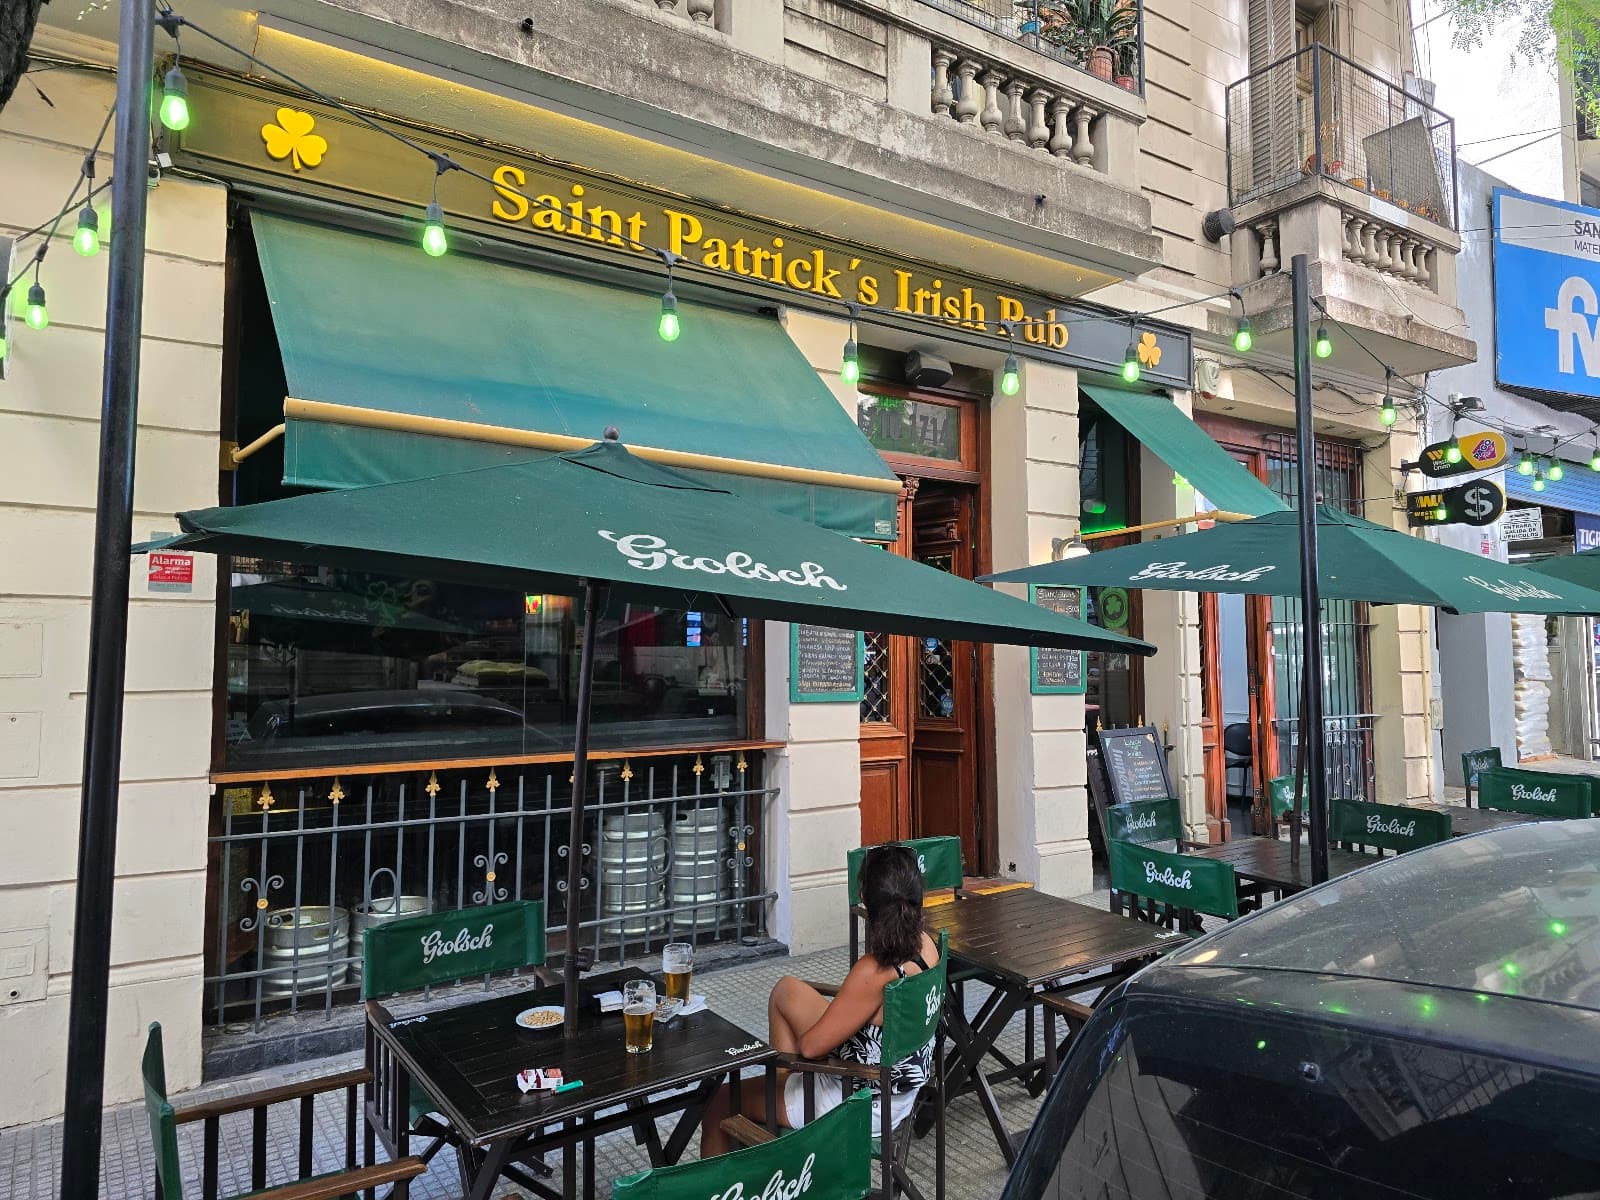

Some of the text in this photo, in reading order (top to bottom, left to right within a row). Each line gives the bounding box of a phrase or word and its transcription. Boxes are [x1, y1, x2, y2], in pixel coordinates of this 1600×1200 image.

[492, 165, 648, 252] Saint
[894, 269, 988, 331] Irish
[996, 295, 1069, 349] Pub
[1574, 239, 1600, 256] MATE
[152, 555, 191, 566] Alarma
[598, 530, 848, 591] Grolsch
[1129, 561, 1276, 582] Grolsch
[1511, 784, 1557, 803] Grolsch
[1126, 811, 1156, 833] Grolsch
[1366, 815, 1416, 837] Grolsch
[1143, 861, 1192, 890] Grolsch
[421, 923, 494, 964] Grolsch
